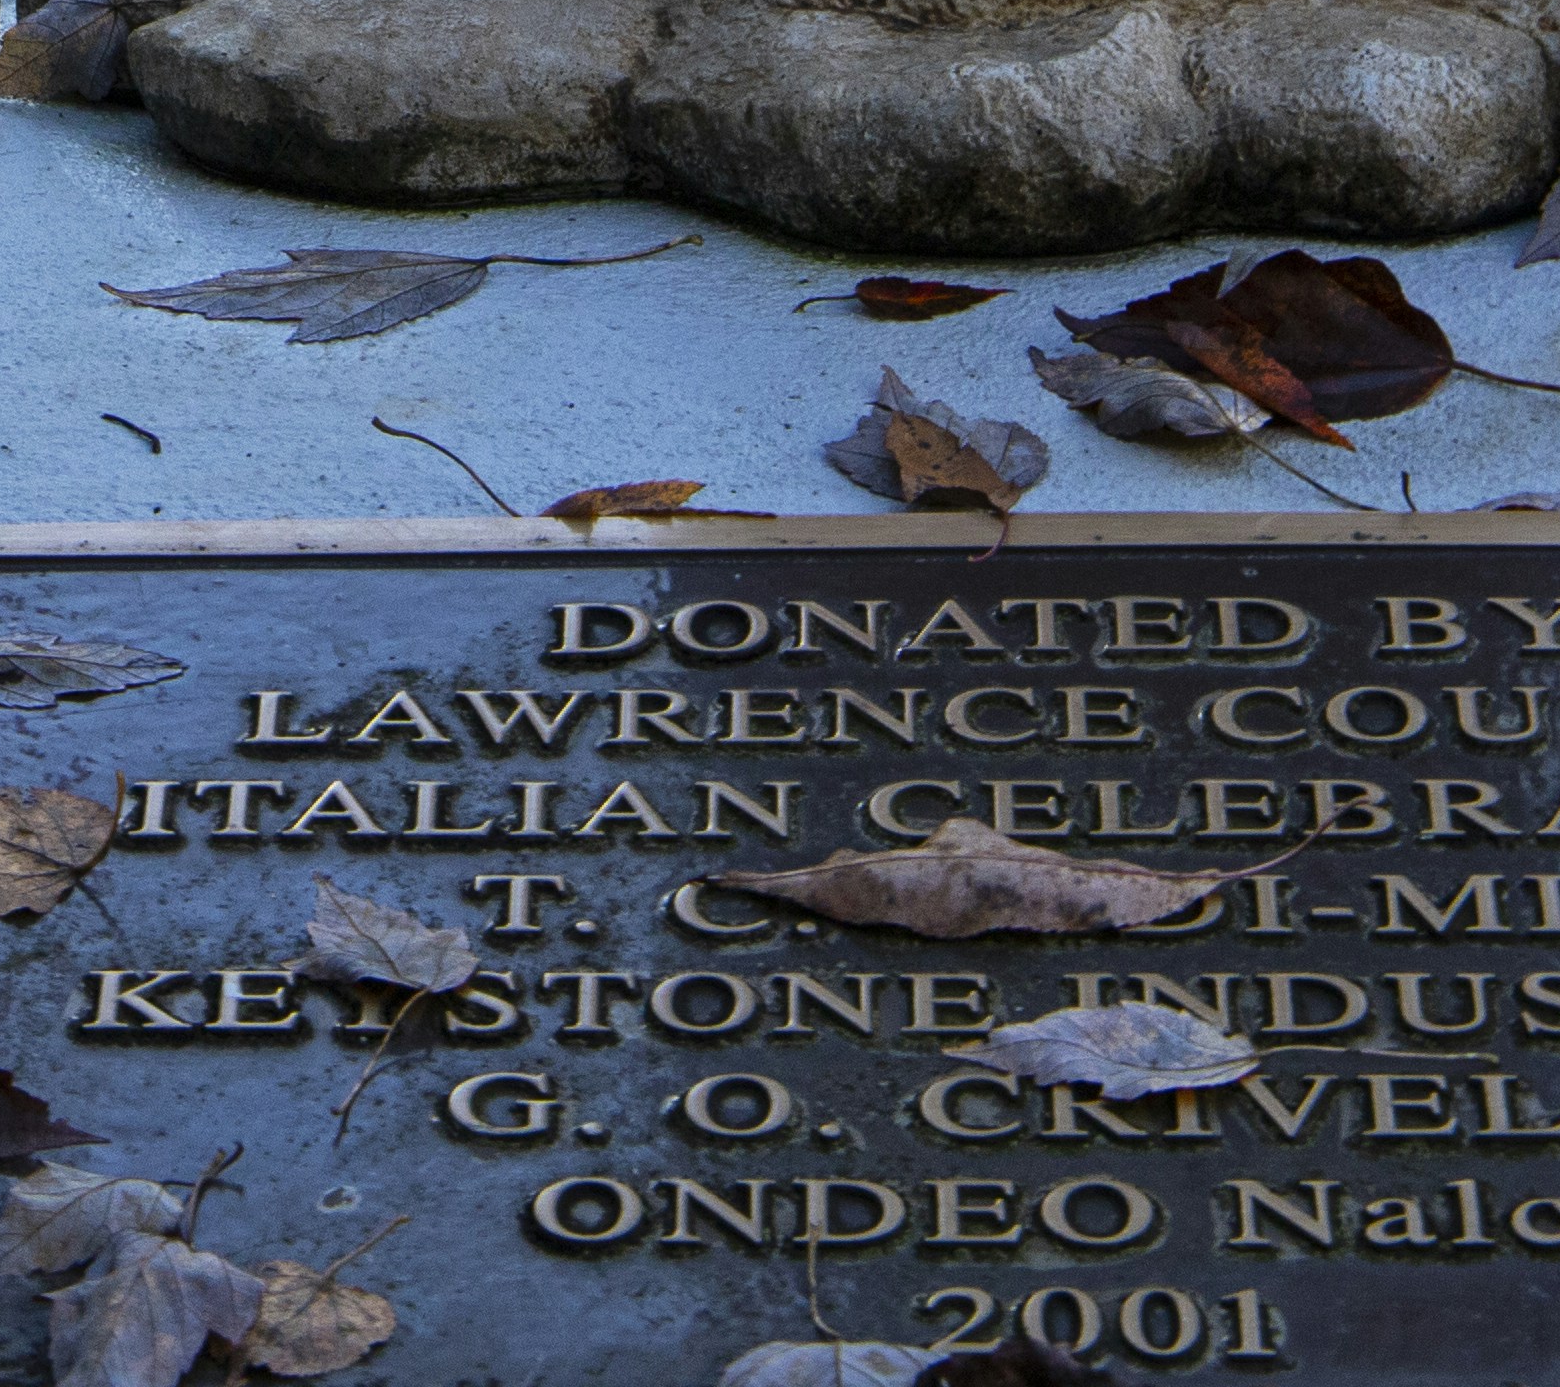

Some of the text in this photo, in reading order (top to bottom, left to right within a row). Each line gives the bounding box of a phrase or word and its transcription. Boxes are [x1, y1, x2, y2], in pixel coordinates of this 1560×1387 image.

[549, 598, 1311, 657] DONATED
[244, 686, 1150, 745] LAWRENCE
[124, 780, 803, 837] ITALIAN
[473, 873, 601, 935] T.
[672, 877, 818, 935] C.
[446, 1072, 605, 1138] G.
[682, 1072, 843, 1138] O.
[532, 1177, 1157, 1246] ONDEO
[924, 1285, 1278, 1356] 2001
